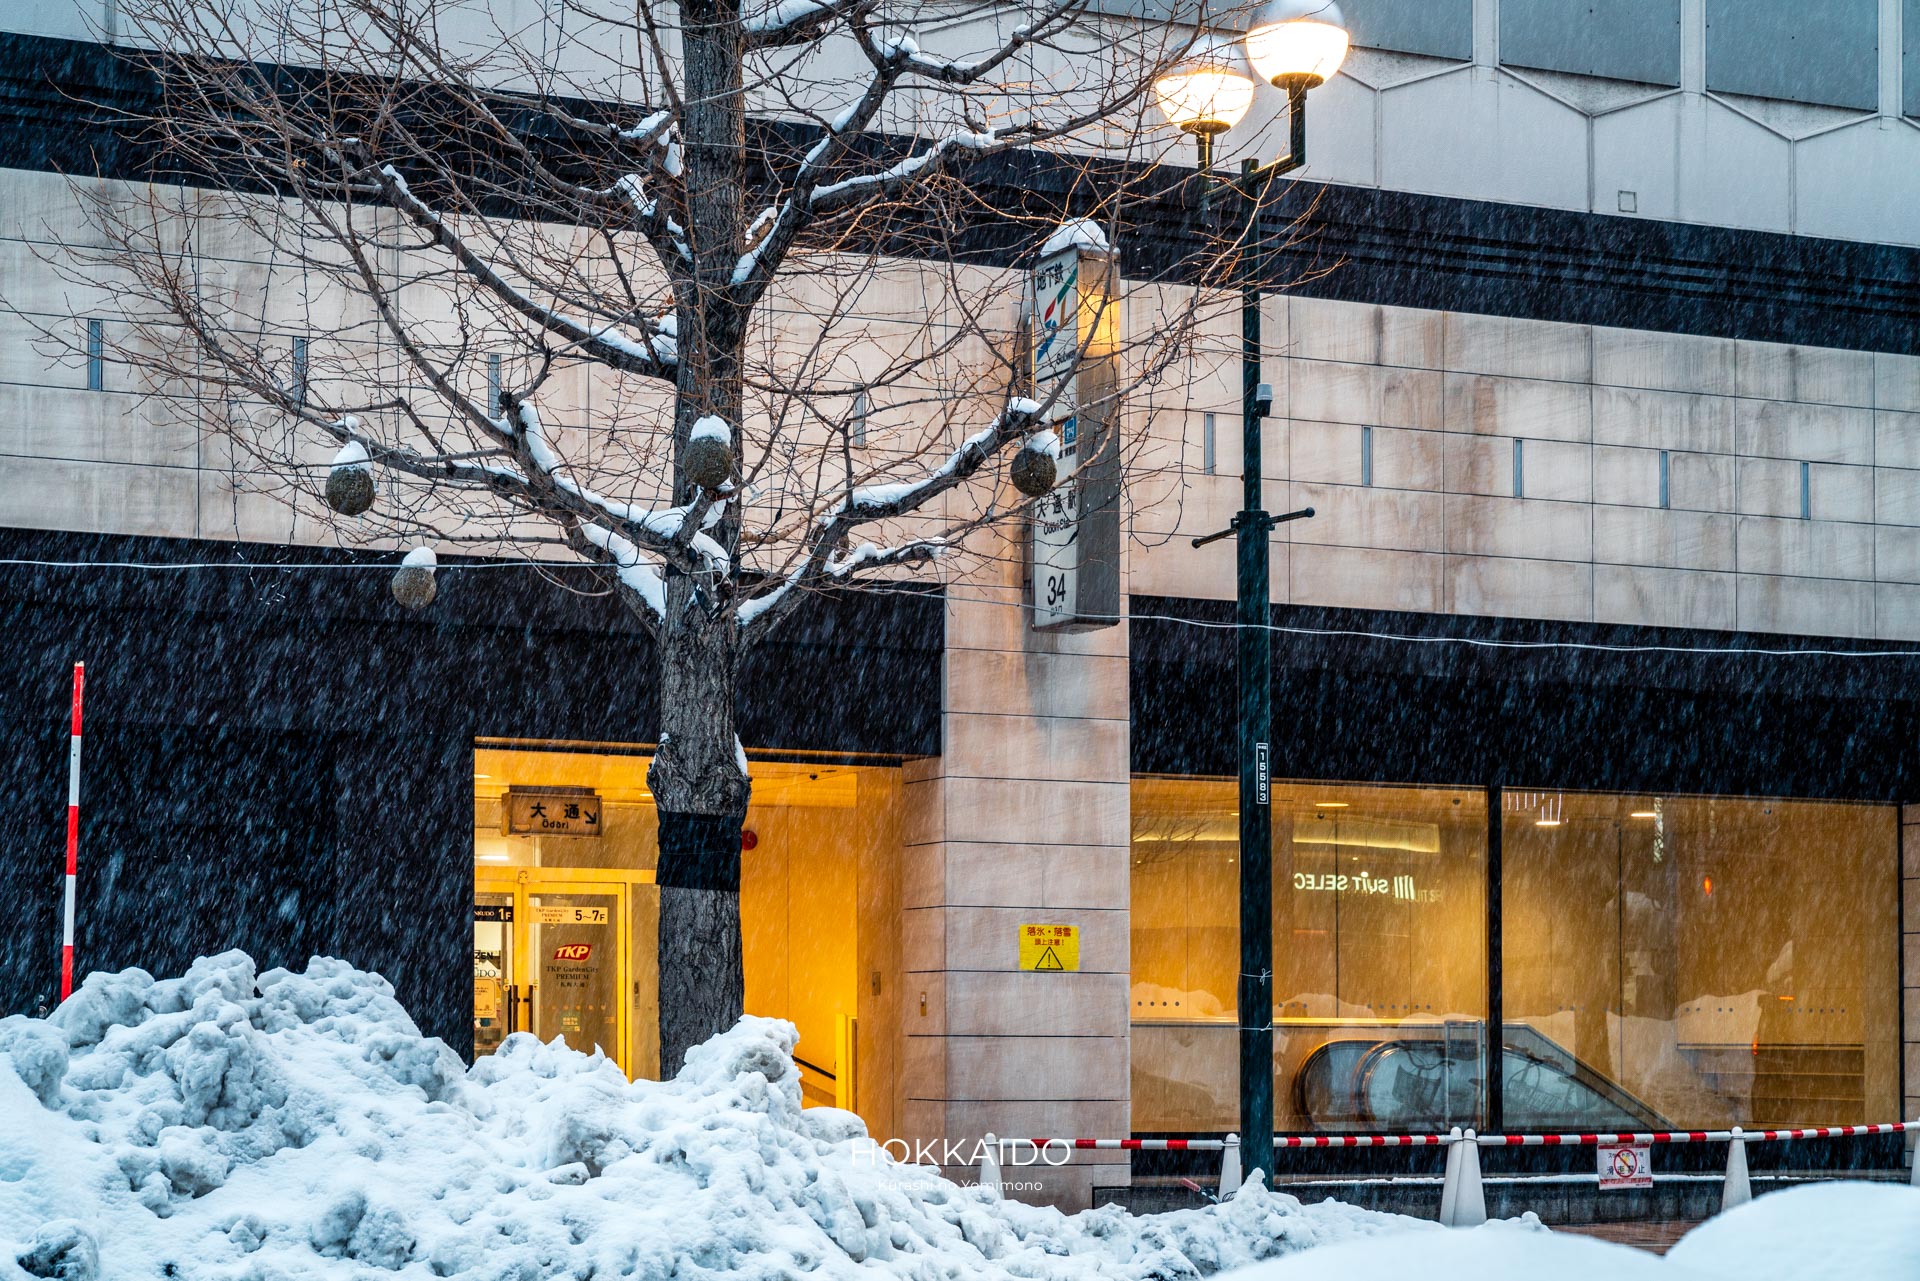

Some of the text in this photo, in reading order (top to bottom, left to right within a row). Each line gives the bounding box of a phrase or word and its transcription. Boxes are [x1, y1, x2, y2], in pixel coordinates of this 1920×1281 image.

[1036, 263, 1064, 292] 地下鉄
[1048, 573, 1066, 606] 34
[1259, 752, 1267, 801] 15583
[530, 802, 580, 819] 大通
[498, 908, 512, 920] 1F
[1027, 926, 1072, 937] 落氷・落雪
[557, 945, 589, 958] TKP
